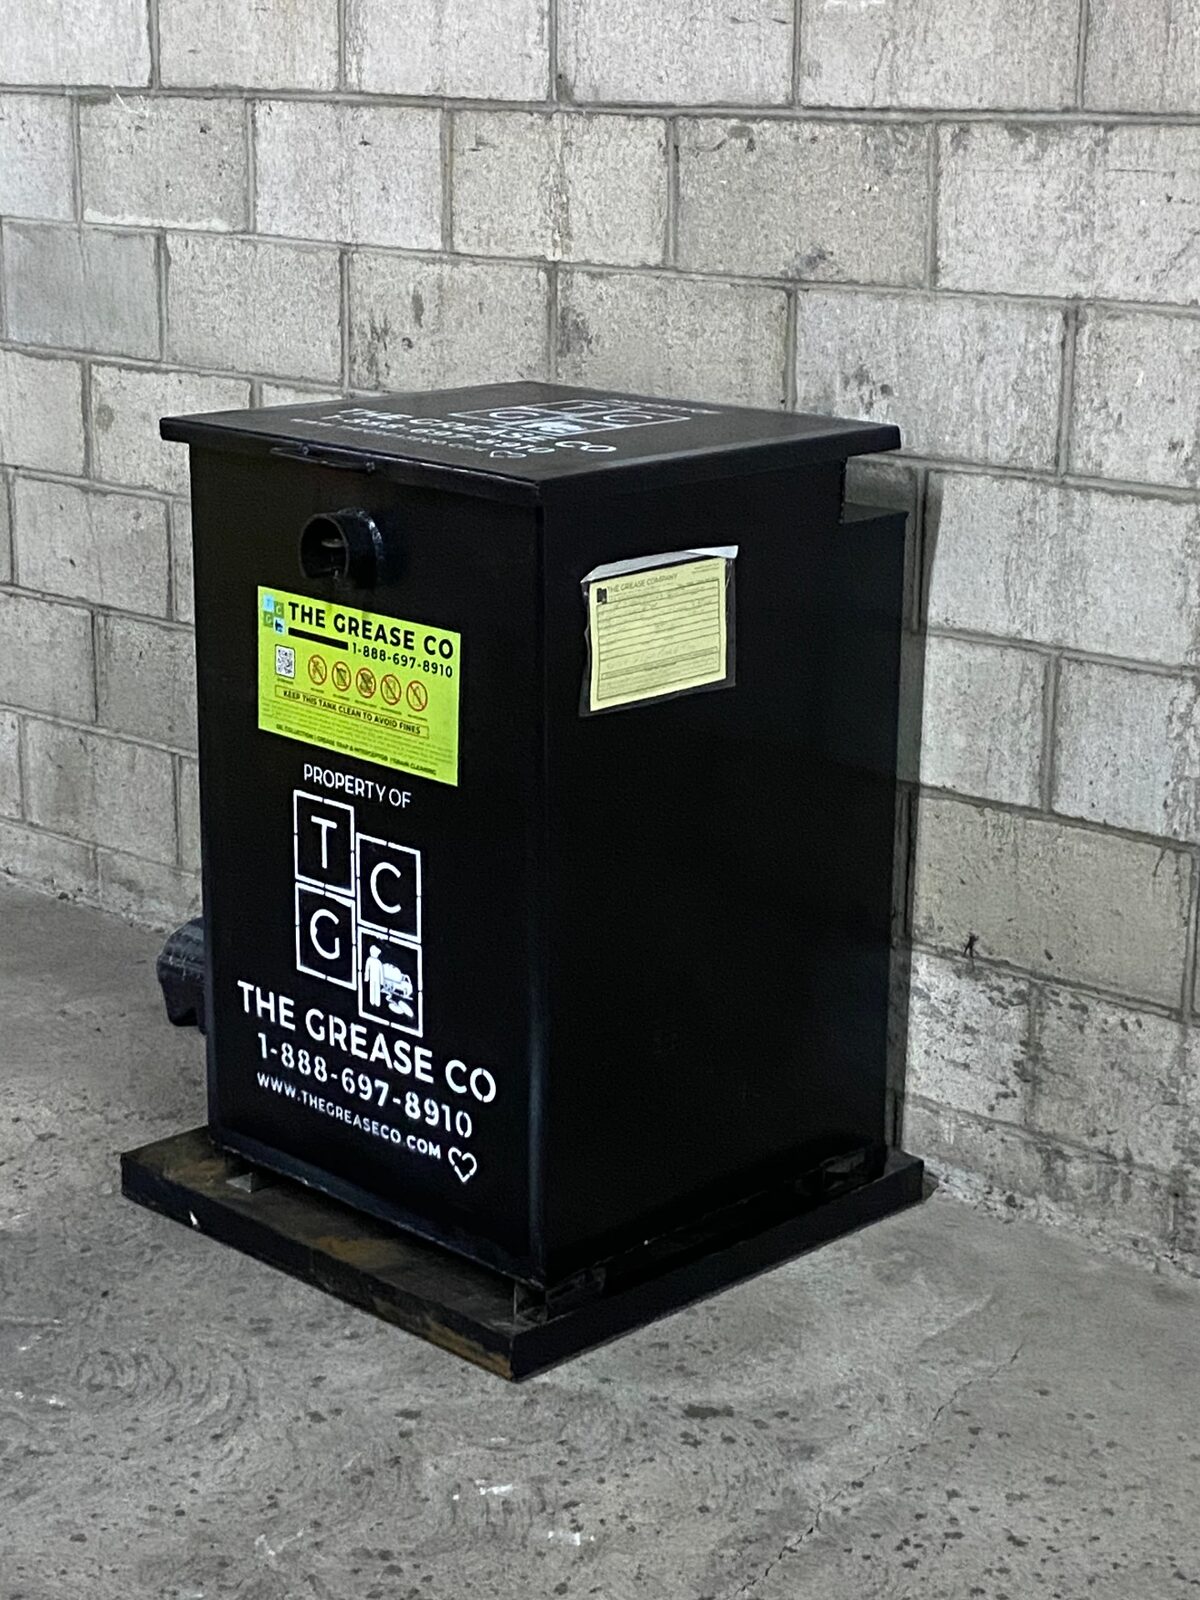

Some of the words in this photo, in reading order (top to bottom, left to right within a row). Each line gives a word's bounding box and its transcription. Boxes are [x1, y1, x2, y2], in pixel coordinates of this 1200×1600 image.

[338, 408, 413, 420] THE
[408, 418, 558, 443] GREASE
[554, 440, 617, 453] CO
[602, 414, 653, 422] C
[620, 579, 645, 591] GREASE
[288, 602, 326, 629] THE
[334, 613, 415, 651] GREASE
[423, 635, 454, 659] CO
[352, 642, 453, 678] 1-888-697-8910
[283, 690, 300, 700] KEEP
[302, 694, 317, 706] THIS
[319, 699, 337, 711] TANK
[338, 704, 361, 718] CLEAN
[362, 711, 373, 721] TO
[374, 715, 398, 728] AVOID
[399, 722, 421, 735] FINES
[303, 763, 385, 803] PROPERTY
[388, 787, 411, 809] OF
[310, 815, 338, 869] T
[369, 862, 402, 915] C
[309, 908, 341, 961] G
[237, 980, 296, 1031] THE
[305, 1007, 434, 1084] GREASE
[445, 1059, 497, 1104] CO
[257, 1032, 474, 1139] 1-888-697-8910
[256, 1071, 441, 1160] WWW.THEGREASECO.COM
